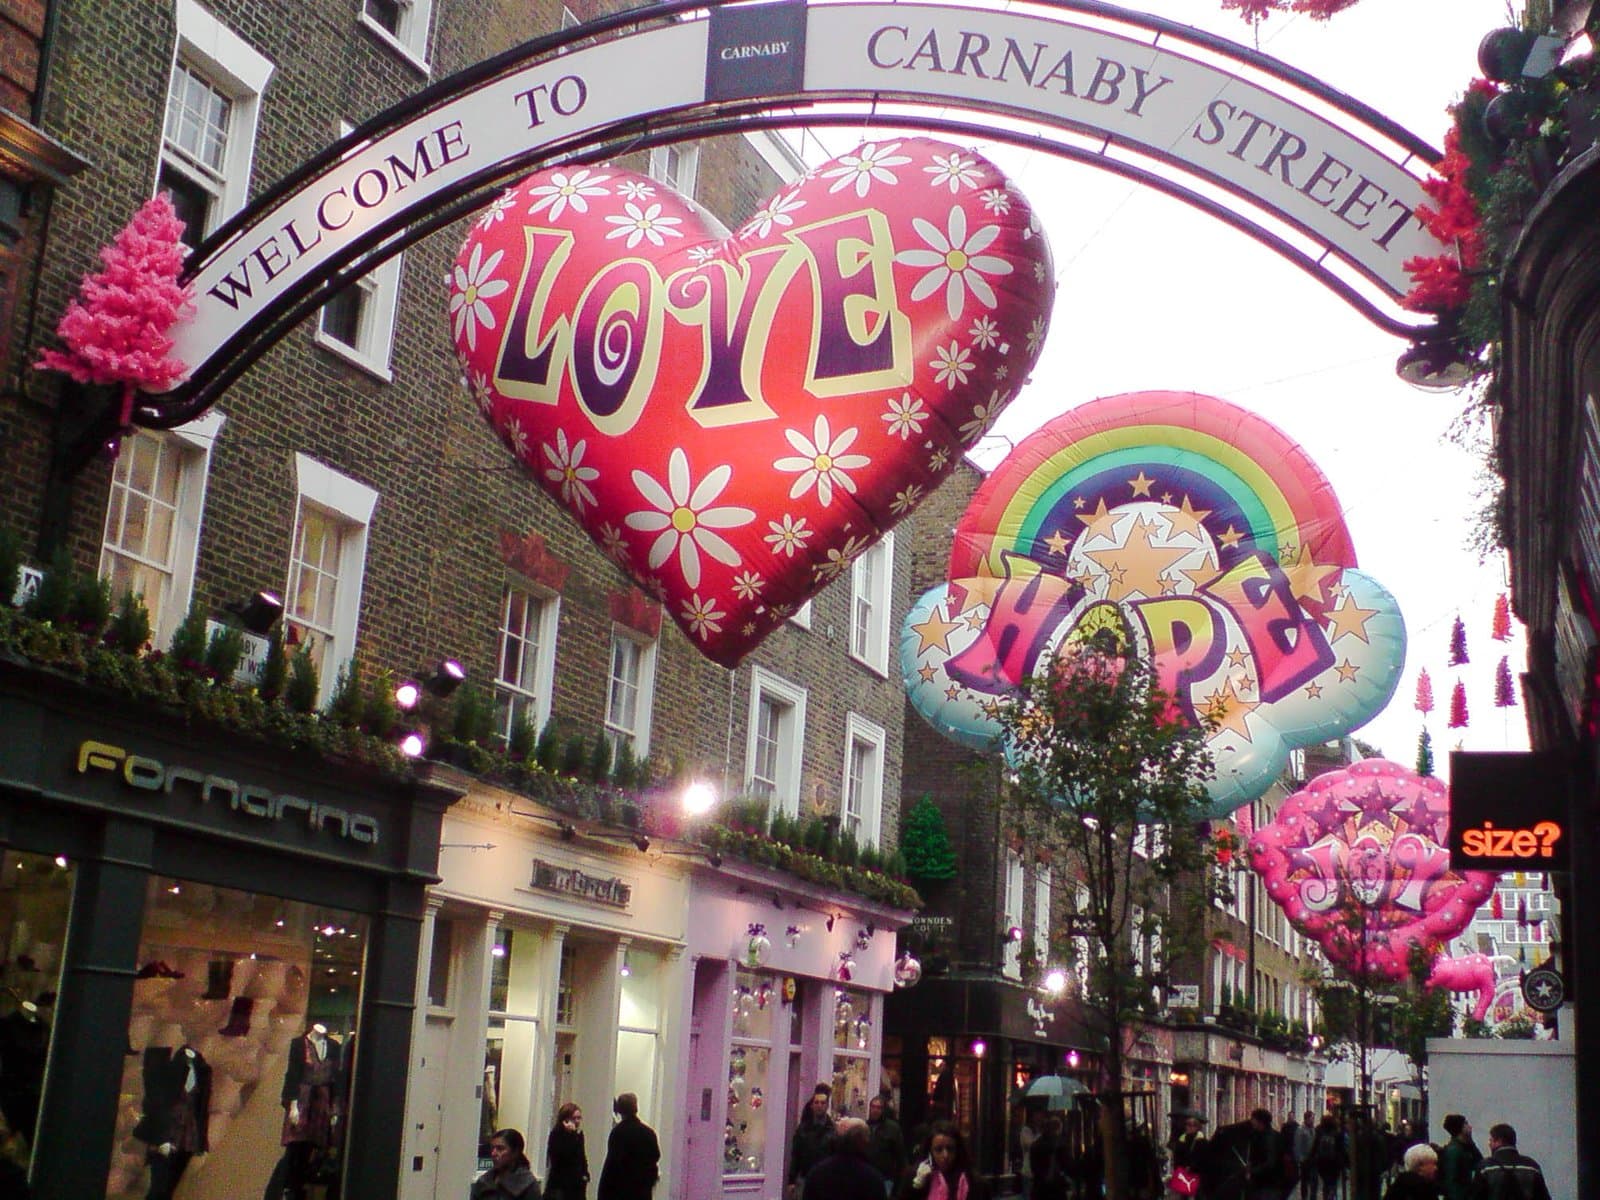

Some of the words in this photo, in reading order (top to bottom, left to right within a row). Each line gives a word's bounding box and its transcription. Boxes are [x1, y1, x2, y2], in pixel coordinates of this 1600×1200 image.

[720, 41, 790, 61] CARNABY
[206, 120, 471, 311] WELCOME
[515, 75, 588, 130] TO
[867, 25, 1173, 118] CARNABY
[1193, 98, 1426, 252] STREET
[493, 208, 914, 436] LOVE
[943, 550, 1337, 732] HOPE
[1300, 832, 1451, 913] JOY
[1462, 821, 1561, 857] size?
[912, 916, 953, 925] OWNDES
